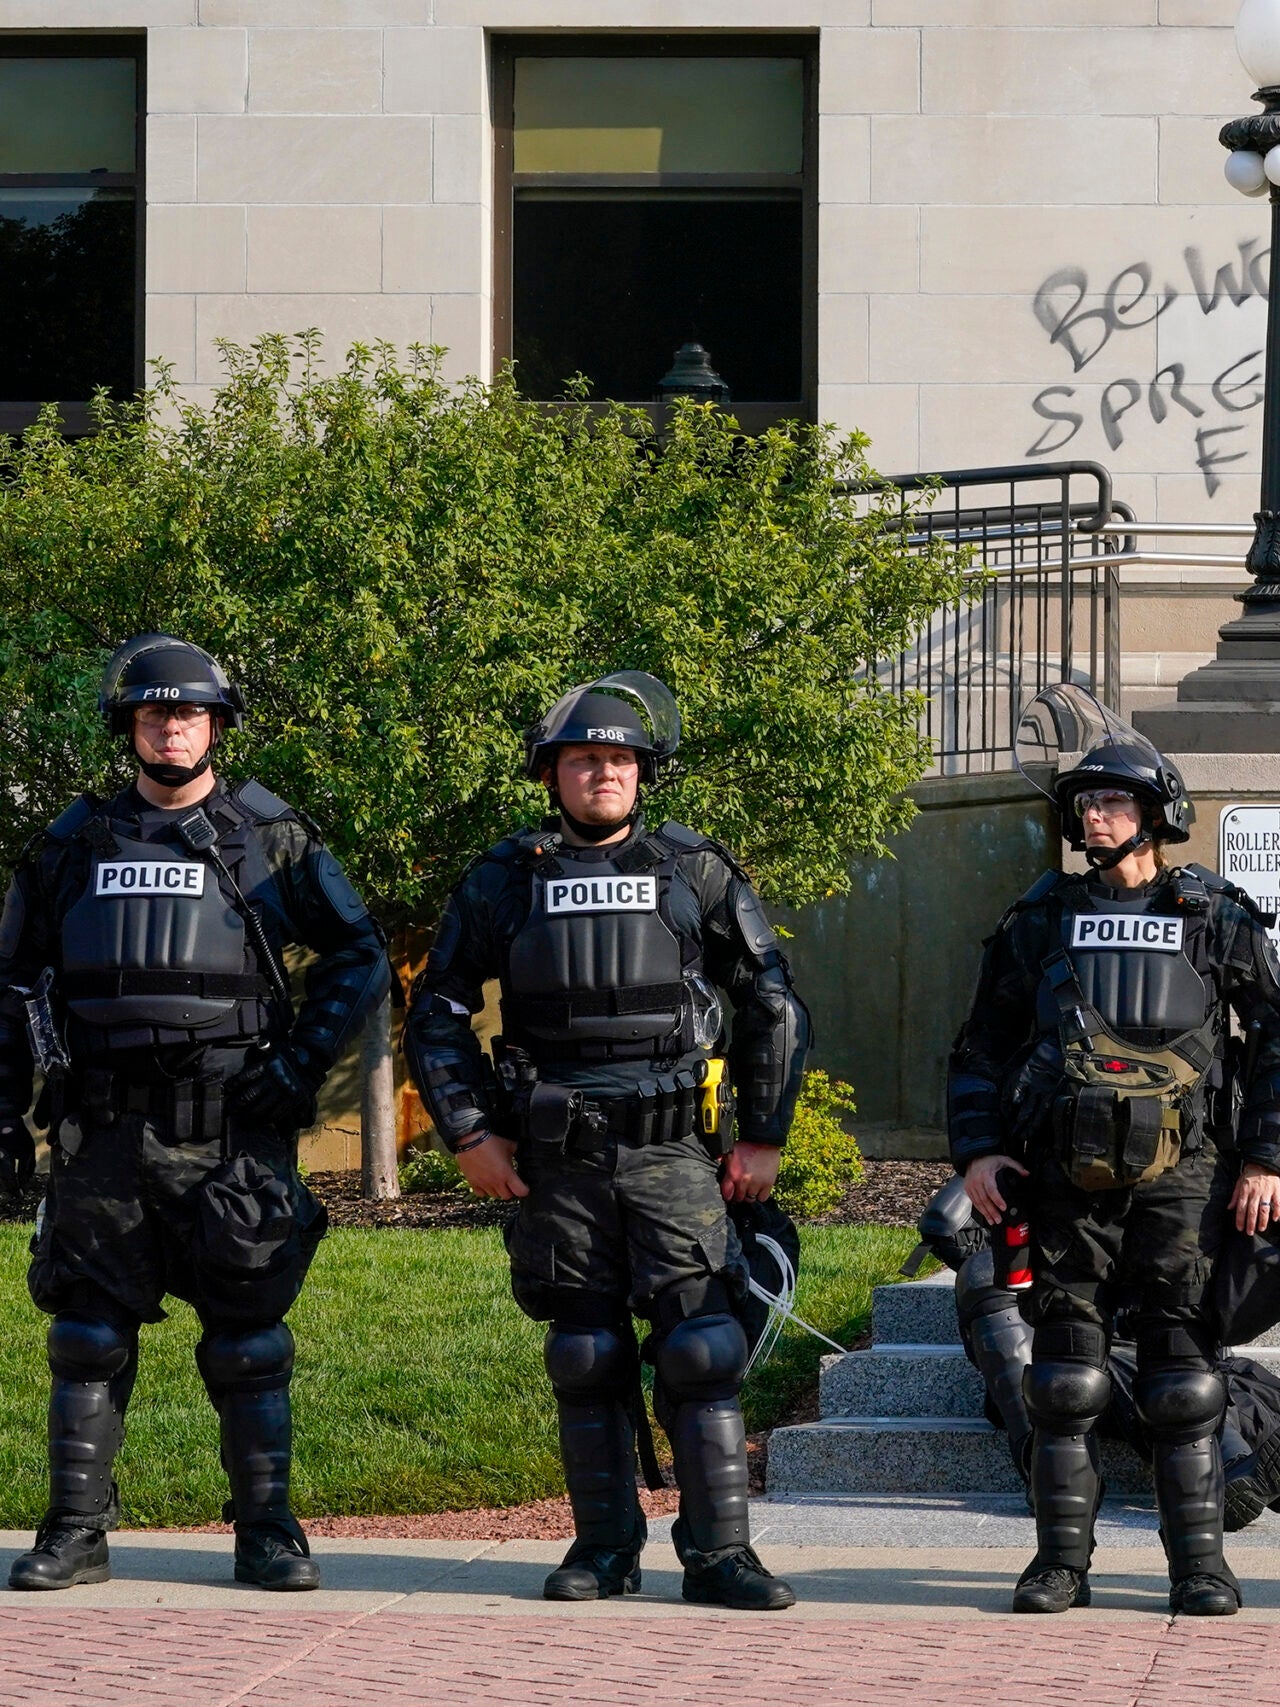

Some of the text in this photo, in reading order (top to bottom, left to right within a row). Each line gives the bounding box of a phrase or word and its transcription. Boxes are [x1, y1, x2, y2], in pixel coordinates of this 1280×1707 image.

[143, 687, 180, 699] F110
[587, 728, 625, 742] F308
[1227, 833, 1280, 850] ROLLER
[102, 867, 198, 889] POLICE
[553, 882, 650, 907] POLICE
[1079, 920, 1177, 944] POLICE
